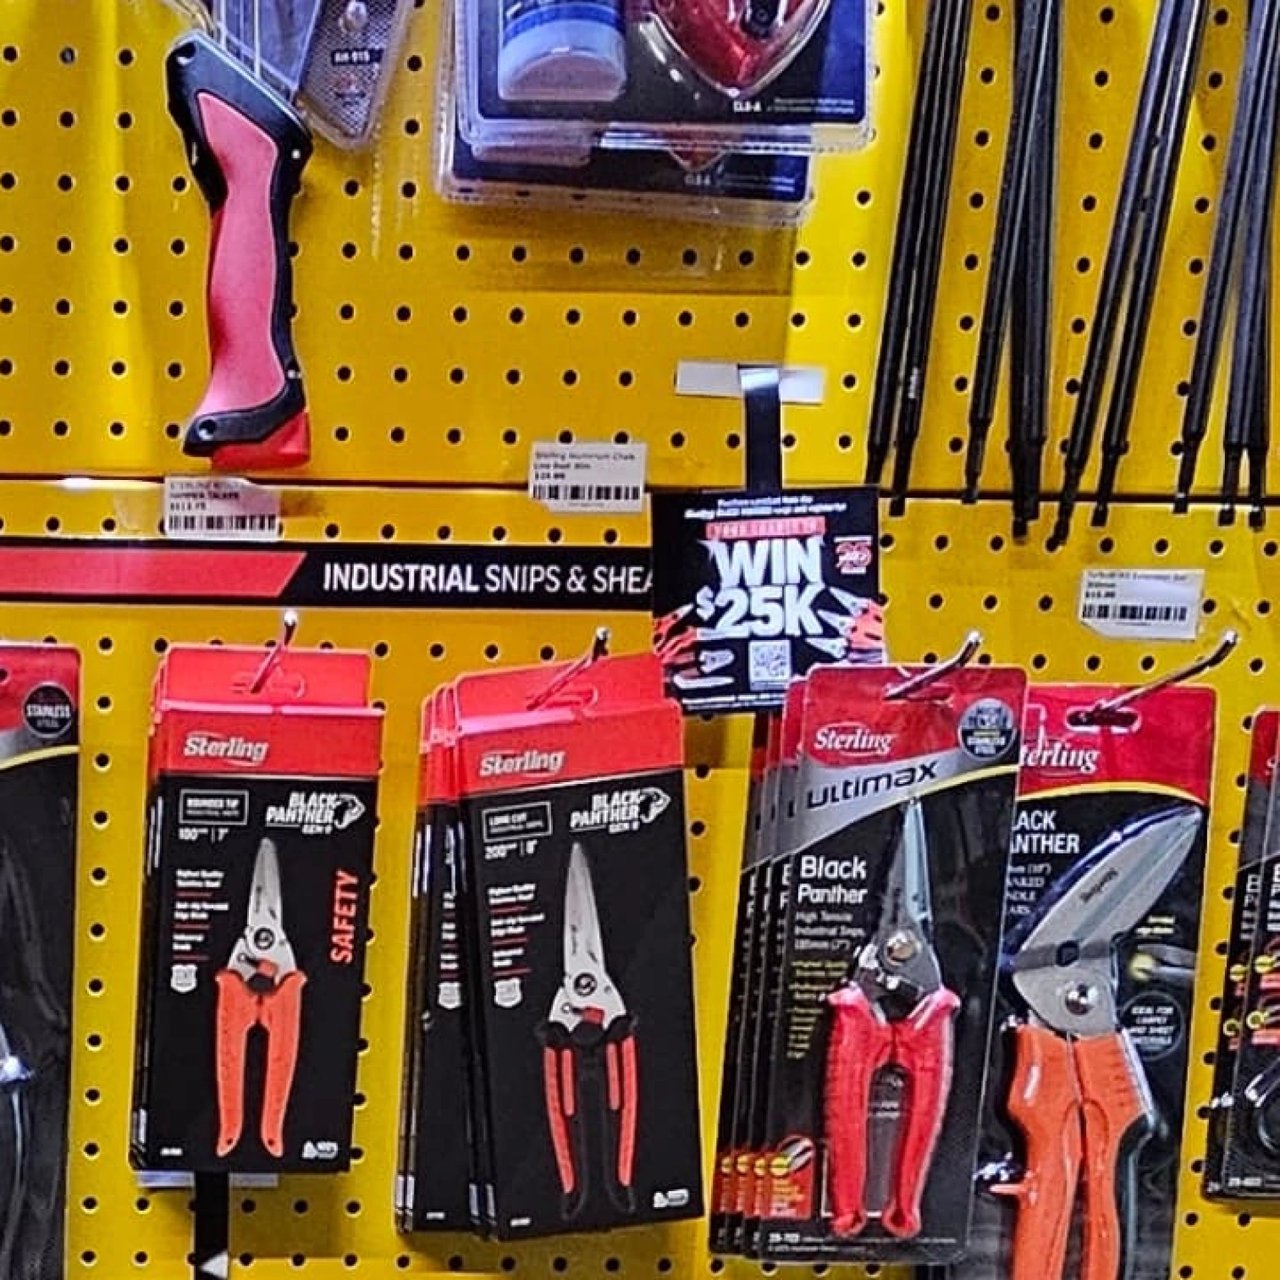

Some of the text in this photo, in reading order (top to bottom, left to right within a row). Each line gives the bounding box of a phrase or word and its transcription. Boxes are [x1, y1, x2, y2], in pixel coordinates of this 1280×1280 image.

[713, 537, 824, 586] WIN
[323, 563, 478, 593] INDUSTRIAL
[484, 566, 560, 593] SNIPS
[566, 569, 585, 593] &
[696, 584, 824, 637] $25K
[25, 703, 72, 719] STAINLESS
[184, 736, 269, 764] Sterling
[815, 728, 894, 755] Sterling
[479, 751, 566, 777] Sterling
[1020, 741, 1100, 773] terling
[807, 761, 939, 809] ultimax
[289, 792, 339, 809] BLACK
[592, 790, 641, 811] BLACK
[266, 806, 334, 825] PANTHER
[570, 805, 641, 828] PANTHER
[800, 854, 867, 880] Black
[797, 883, 868, 905] Panther
[331, 869, 359, 964] SAFETY
